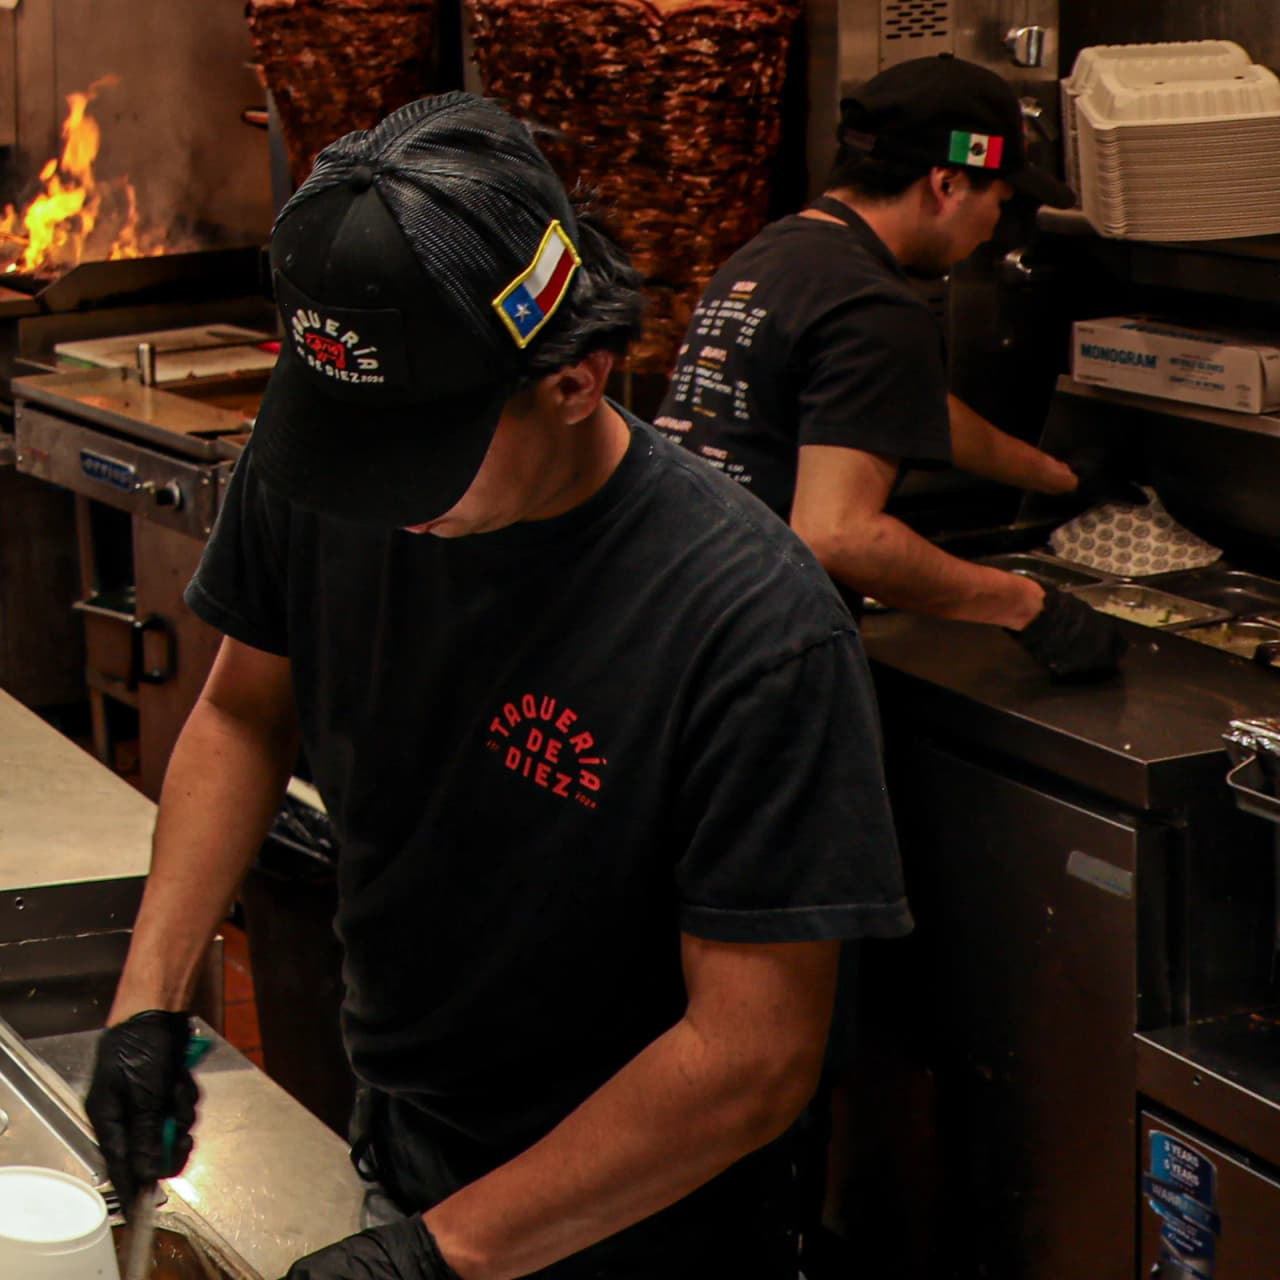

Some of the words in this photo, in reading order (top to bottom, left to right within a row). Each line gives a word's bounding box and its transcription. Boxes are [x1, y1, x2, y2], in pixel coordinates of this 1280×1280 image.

[1080, 343, 1158, 369] MONOGRAM
[526, 727, 563, 764] DE
[504, 746, 572, 798] DIEZ
